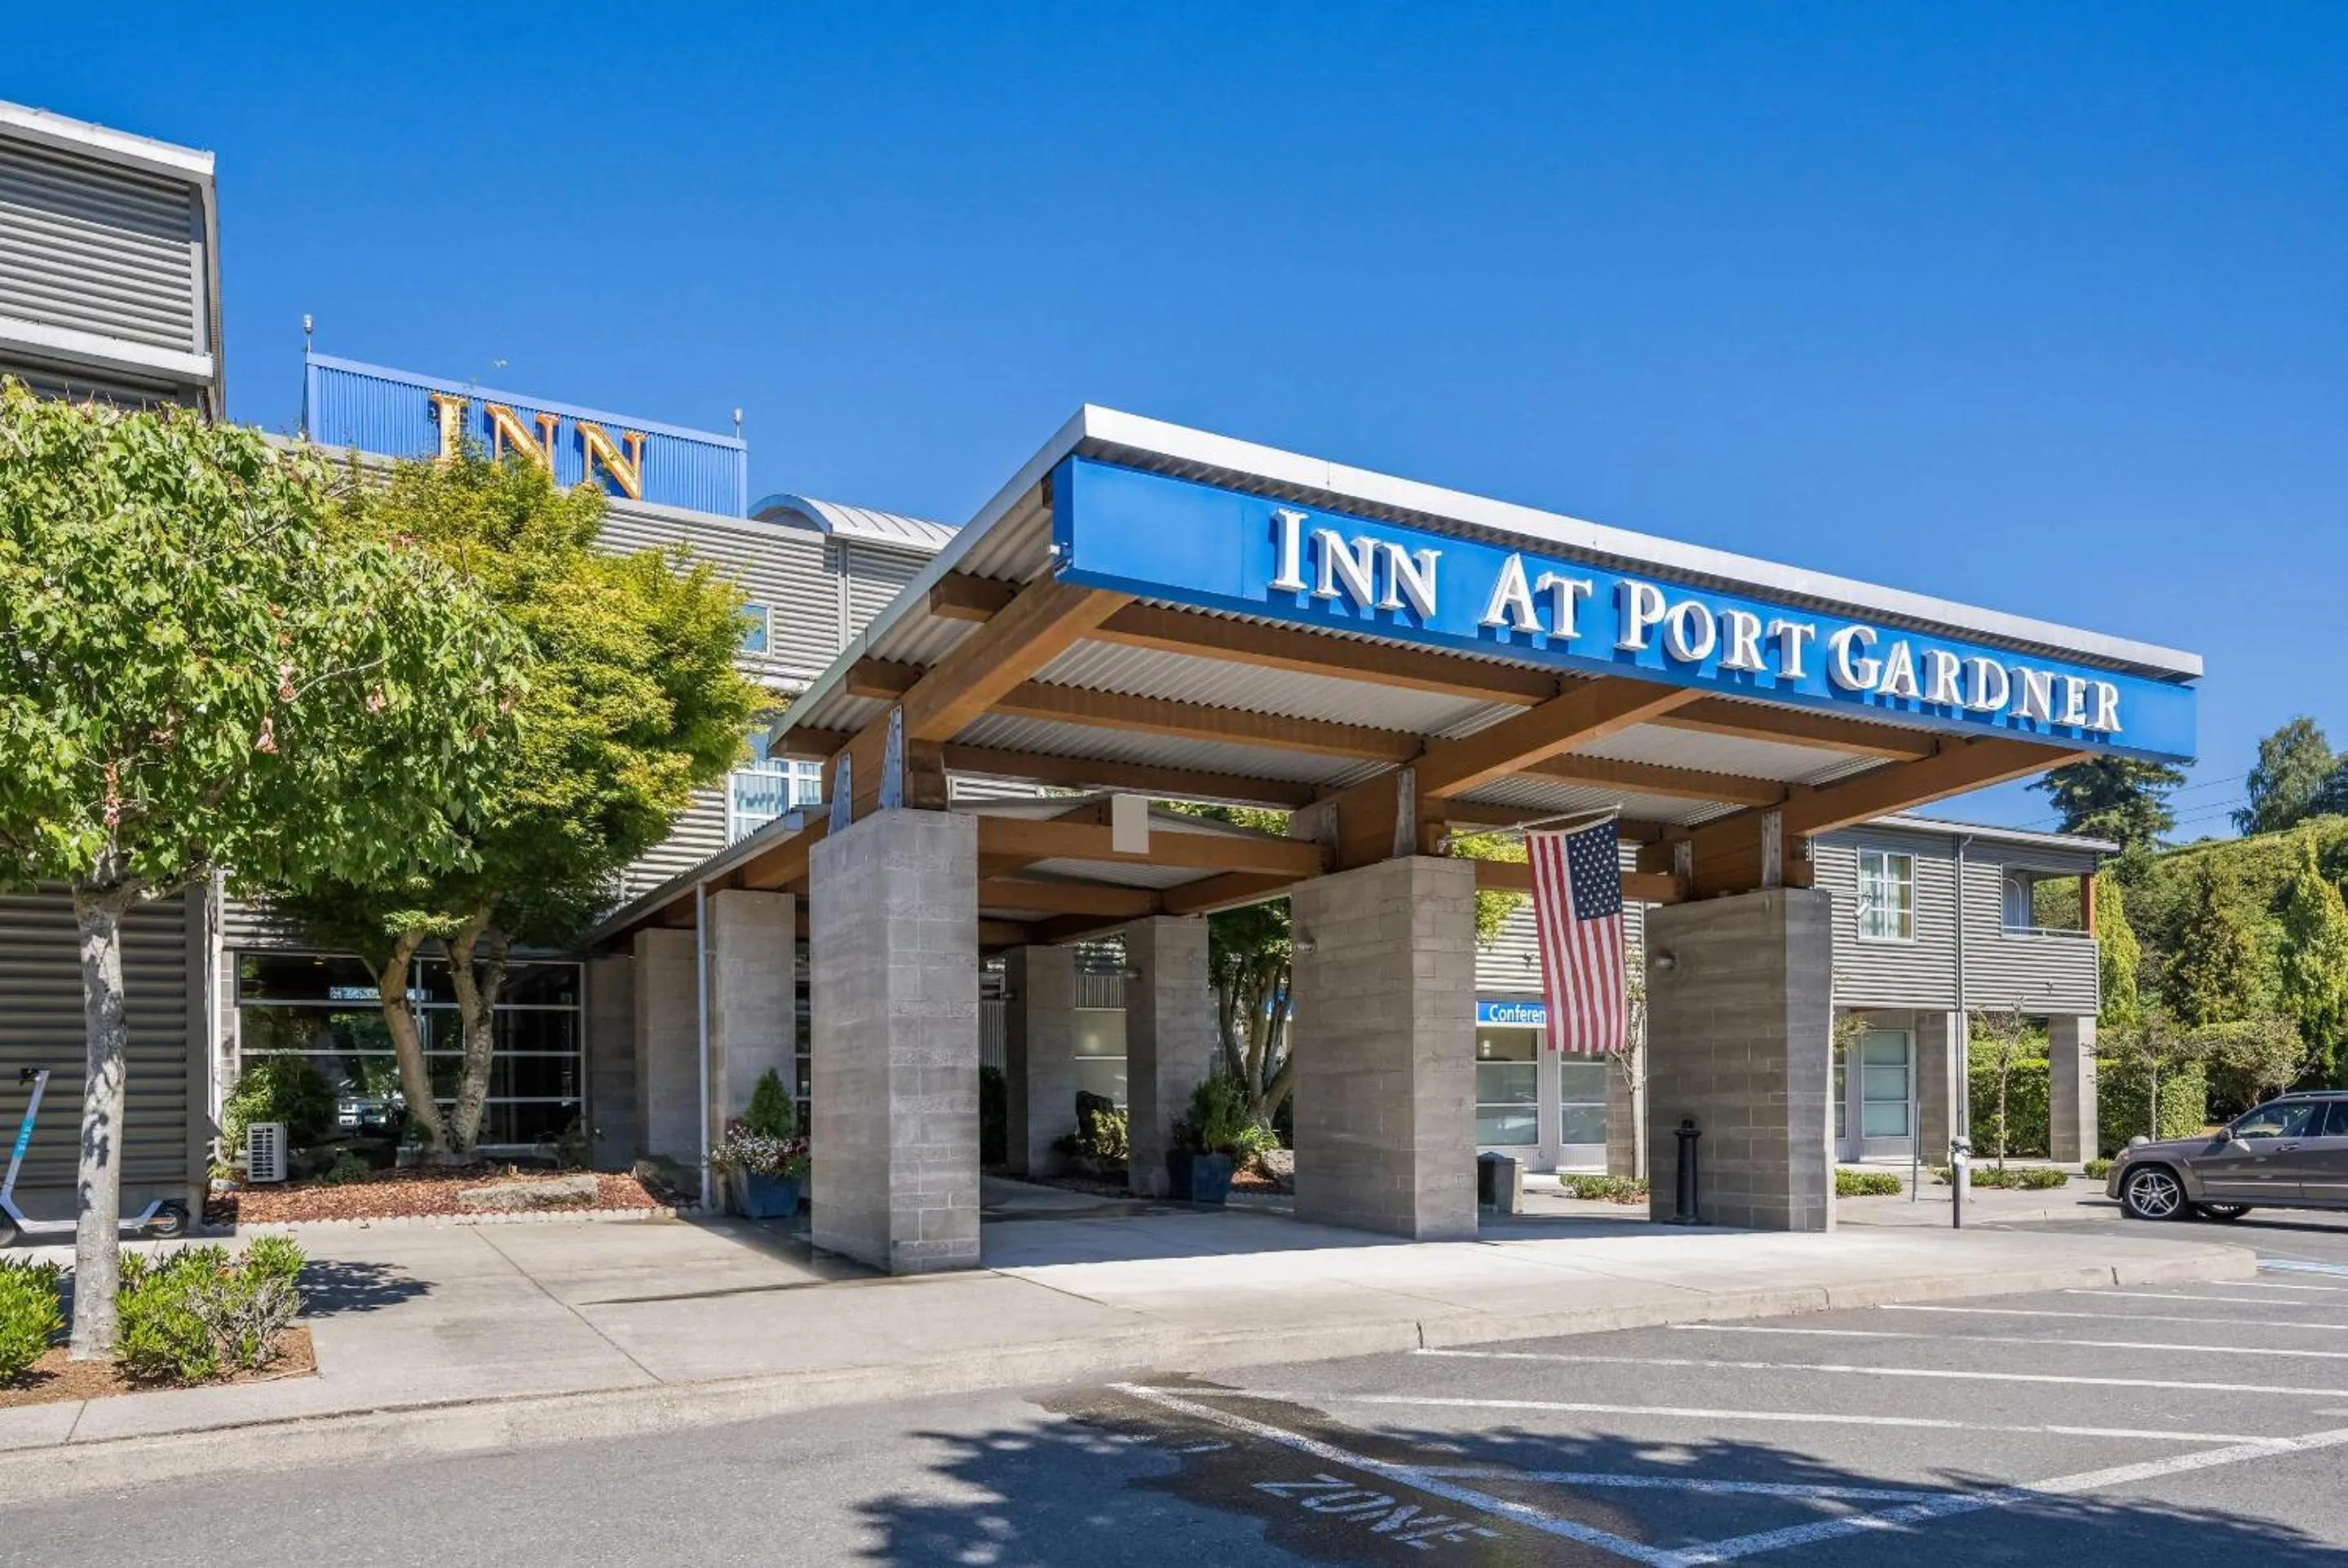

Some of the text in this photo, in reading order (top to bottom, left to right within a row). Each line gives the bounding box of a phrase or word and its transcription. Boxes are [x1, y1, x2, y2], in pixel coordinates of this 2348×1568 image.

[429, 392, 648, 500] INN
[1271, 508, 1442, 619] INN
[1615, 579, 1815, 679] PORT
[1828, 625, 2123, 731] GARDNER
[1251, 1473, 1502, 1550] ZONE
